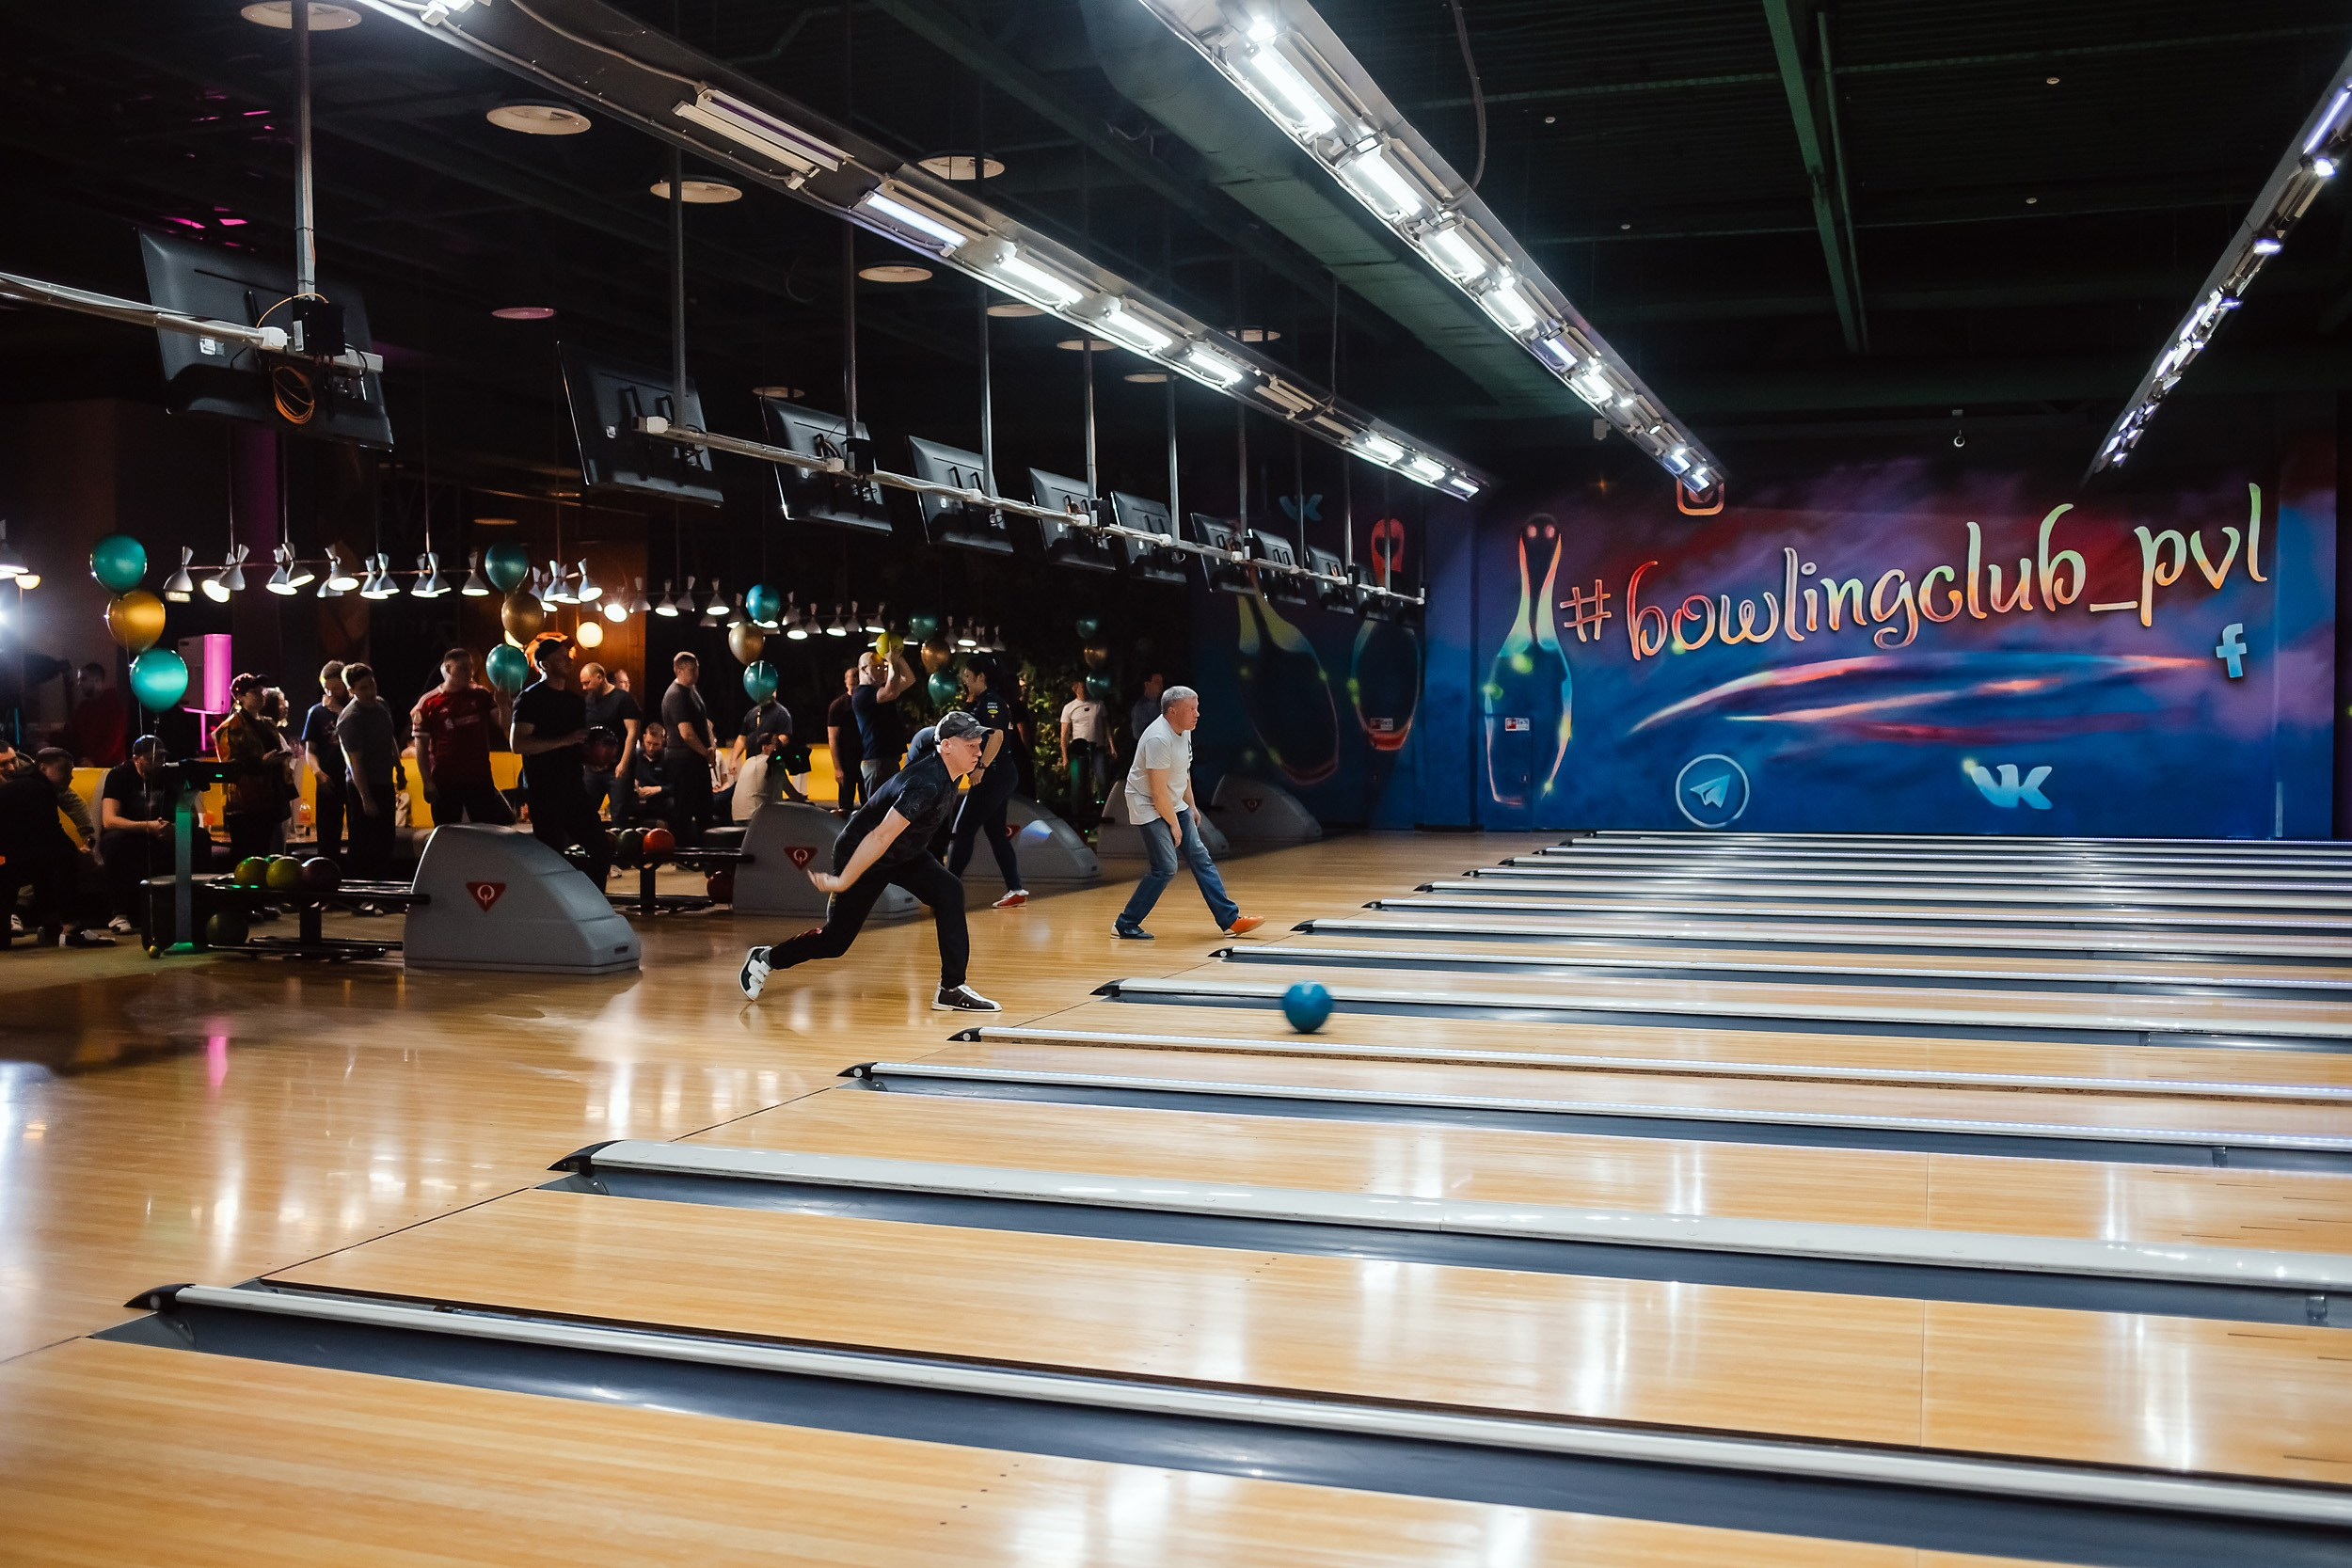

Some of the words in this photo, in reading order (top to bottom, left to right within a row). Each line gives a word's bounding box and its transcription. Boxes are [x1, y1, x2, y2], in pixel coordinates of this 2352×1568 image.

[1559, 482, 2268, 660] #bowlingclub_pvl
[2216, 623, 2248, 678] f
[792, 848, 808, 865] Q
[476, 884, 495, 906] Q
